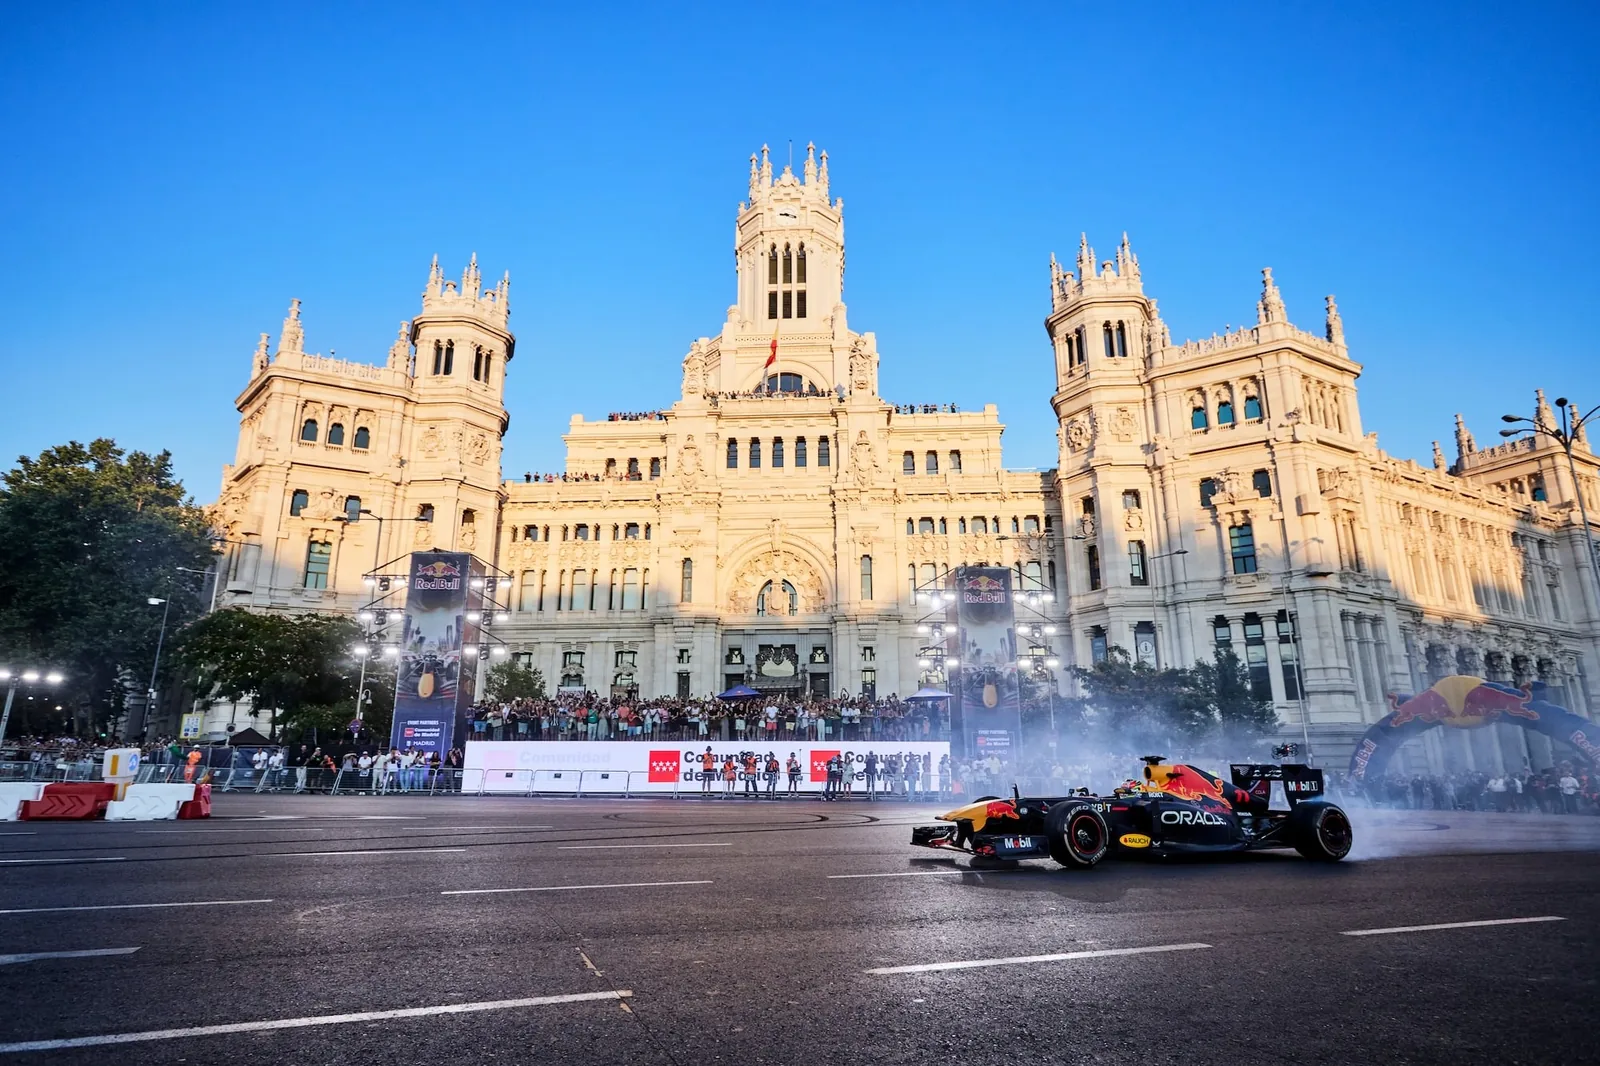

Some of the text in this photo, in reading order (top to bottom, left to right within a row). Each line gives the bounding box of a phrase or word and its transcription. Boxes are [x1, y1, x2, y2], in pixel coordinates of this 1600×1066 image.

[415, 578, 460, 590] Red Bull
[964, 592, 1005, 603] Red Bull
[1570, 730, 1600, 757] Red
[1357, 739, 1377, 761] Bull
[1288, 781, 1309, 792] Mobil
[1091, 802, 1111, 813] YBIT
[1004, 837, 1032, 849] Mobil
